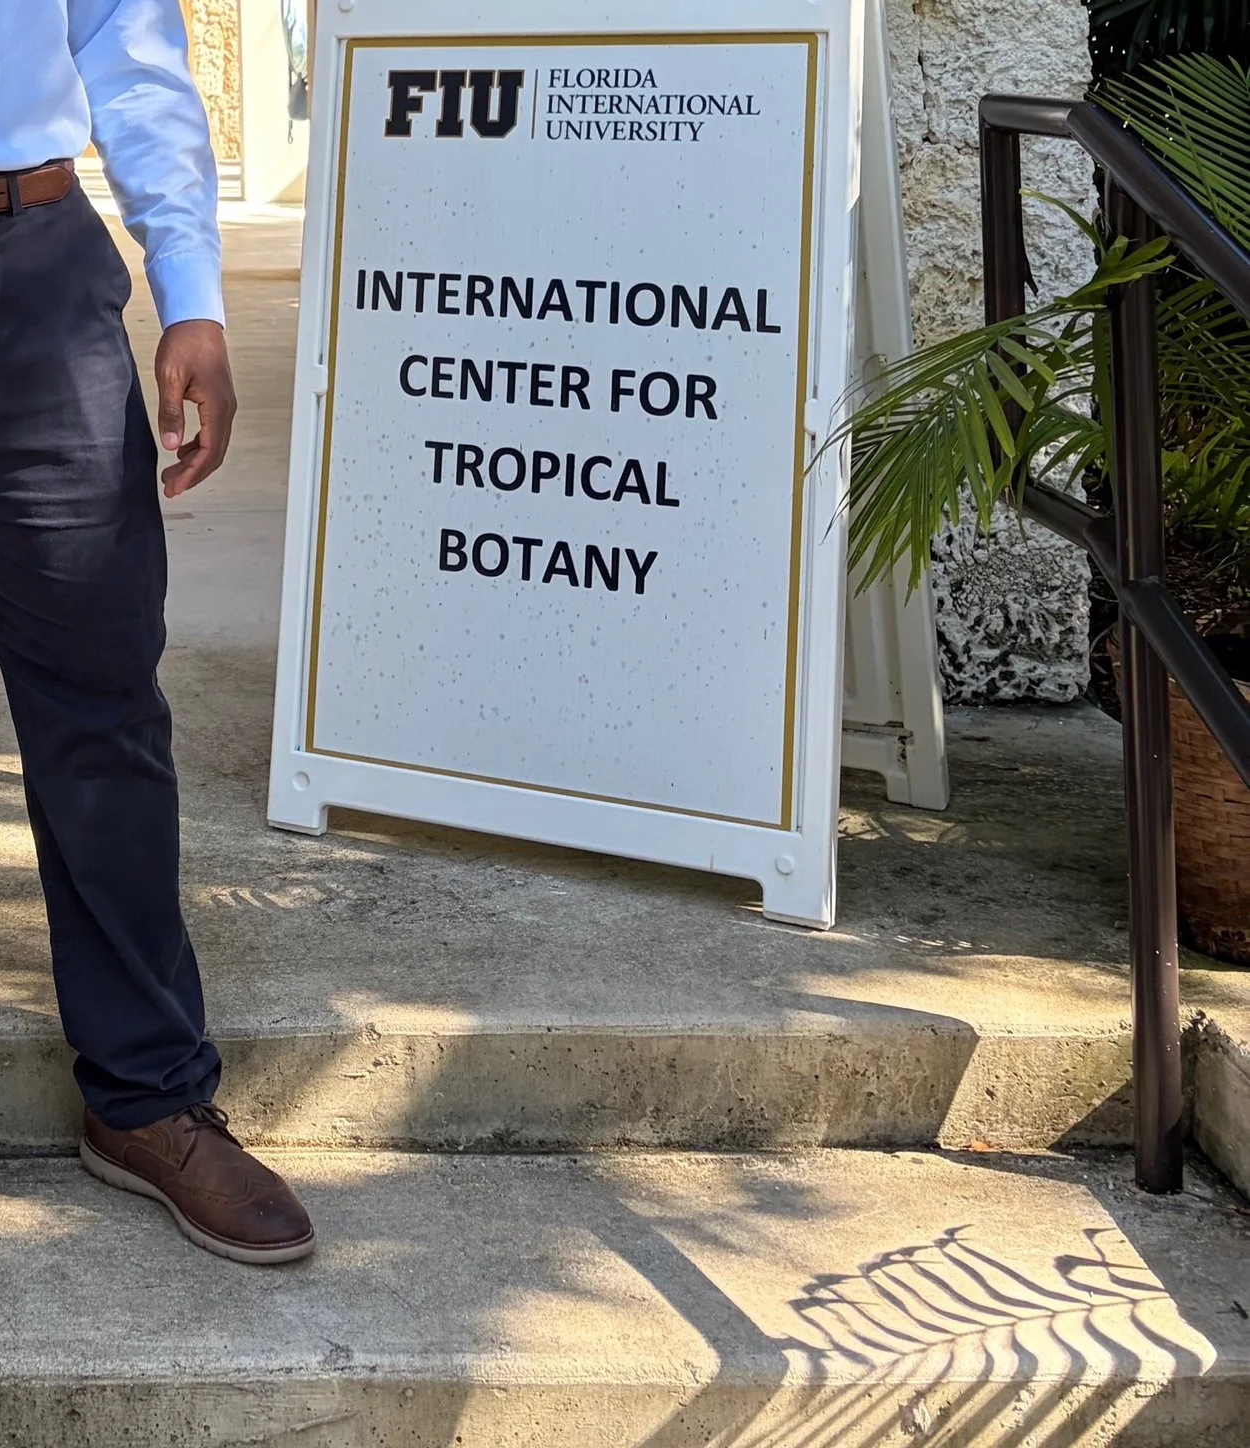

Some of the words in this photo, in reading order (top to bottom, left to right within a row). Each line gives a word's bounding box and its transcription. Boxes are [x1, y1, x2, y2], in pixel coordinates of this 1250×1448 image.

[384, 69, 525, 140] FIU
[546, 94, 761, 117] INTERNATIONAL
[547, 68, 658, 90] FLORIDA
[546, 119, 705, 143] UNIVERSITY
[356, 268, 782, 334] INTERNATIONAL
[399, 354, 591, 411] CENTER
[610, 368, 718, 421] FOR
[424, 440, 681, 508] TROPICAL
[439, 528, 659, 596] BOTANY
